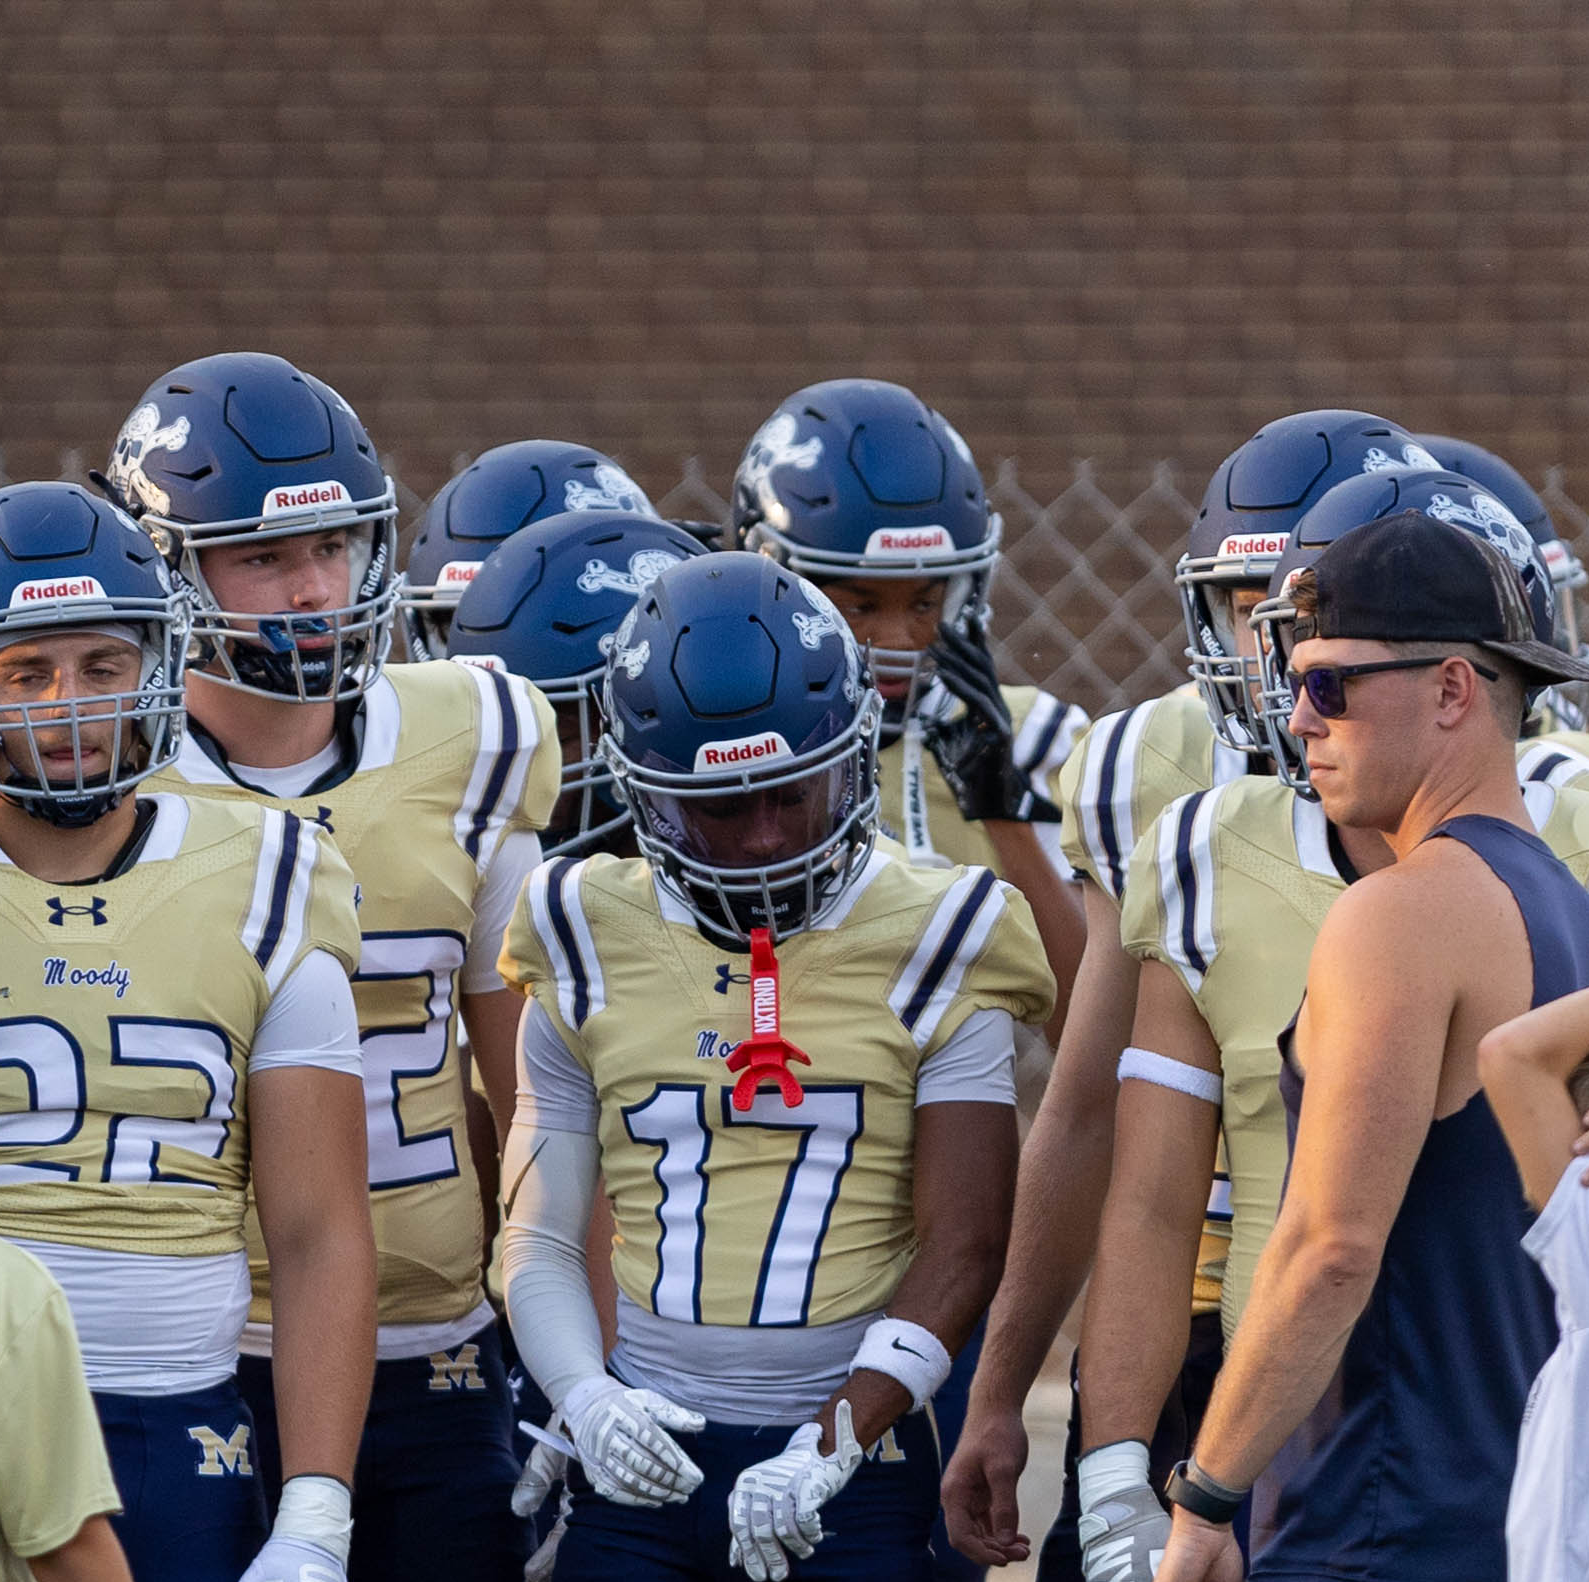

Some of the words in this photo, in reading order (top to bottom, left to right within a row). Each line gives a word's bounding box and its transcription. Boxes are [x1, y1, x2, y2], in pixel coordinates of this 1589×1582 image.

[275, 486, 342, 508] Riddell
[880, 531, 944, 549] Riddell
[21, 579, 94, 602] Riddell
[361, 542, 389, 600] Riddell
[446, 566, 477, 582] Rid
[704, 738, 779, 765] Riddell
[43, 957, 132, 999] Moody
[753, 976, 777, 1034] NXTRND
[621, 1083, 865, 1328] 17
[426, 1343, 489, 1390] M
[187, 1425, 254, 1476] M
